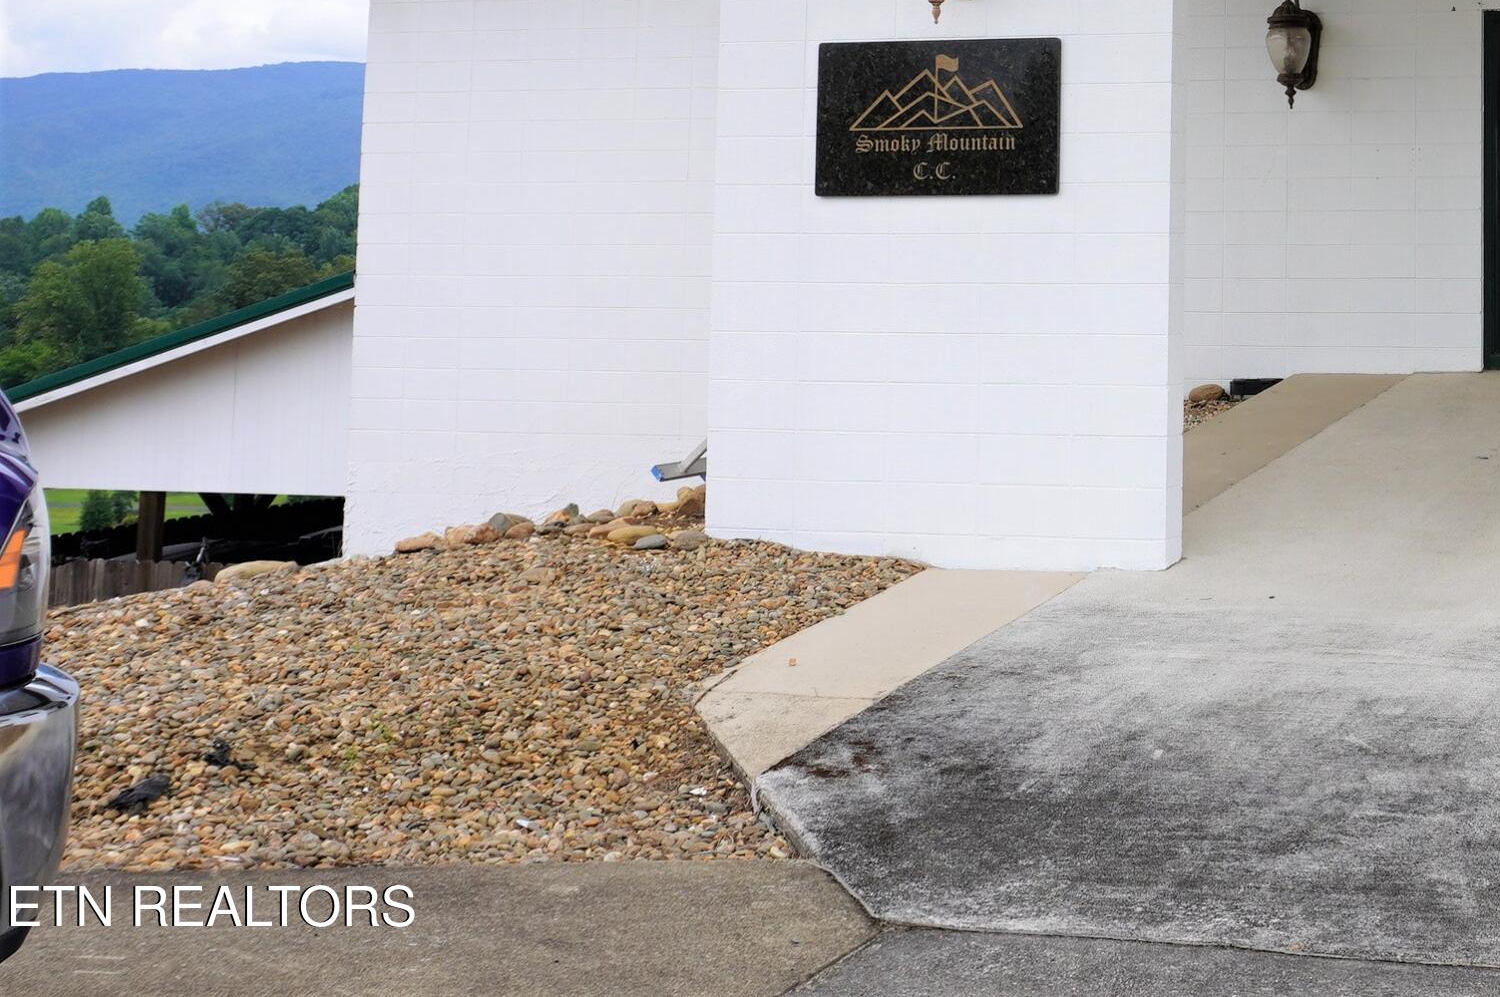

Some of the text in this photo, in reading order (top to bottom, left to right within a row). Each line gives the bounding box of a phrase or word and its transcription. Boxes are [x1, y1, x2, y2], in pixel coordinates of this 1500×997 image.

[855, 132, 1016, 154] Smoky Mountain
[913, 162, 957, 180] C.C.
